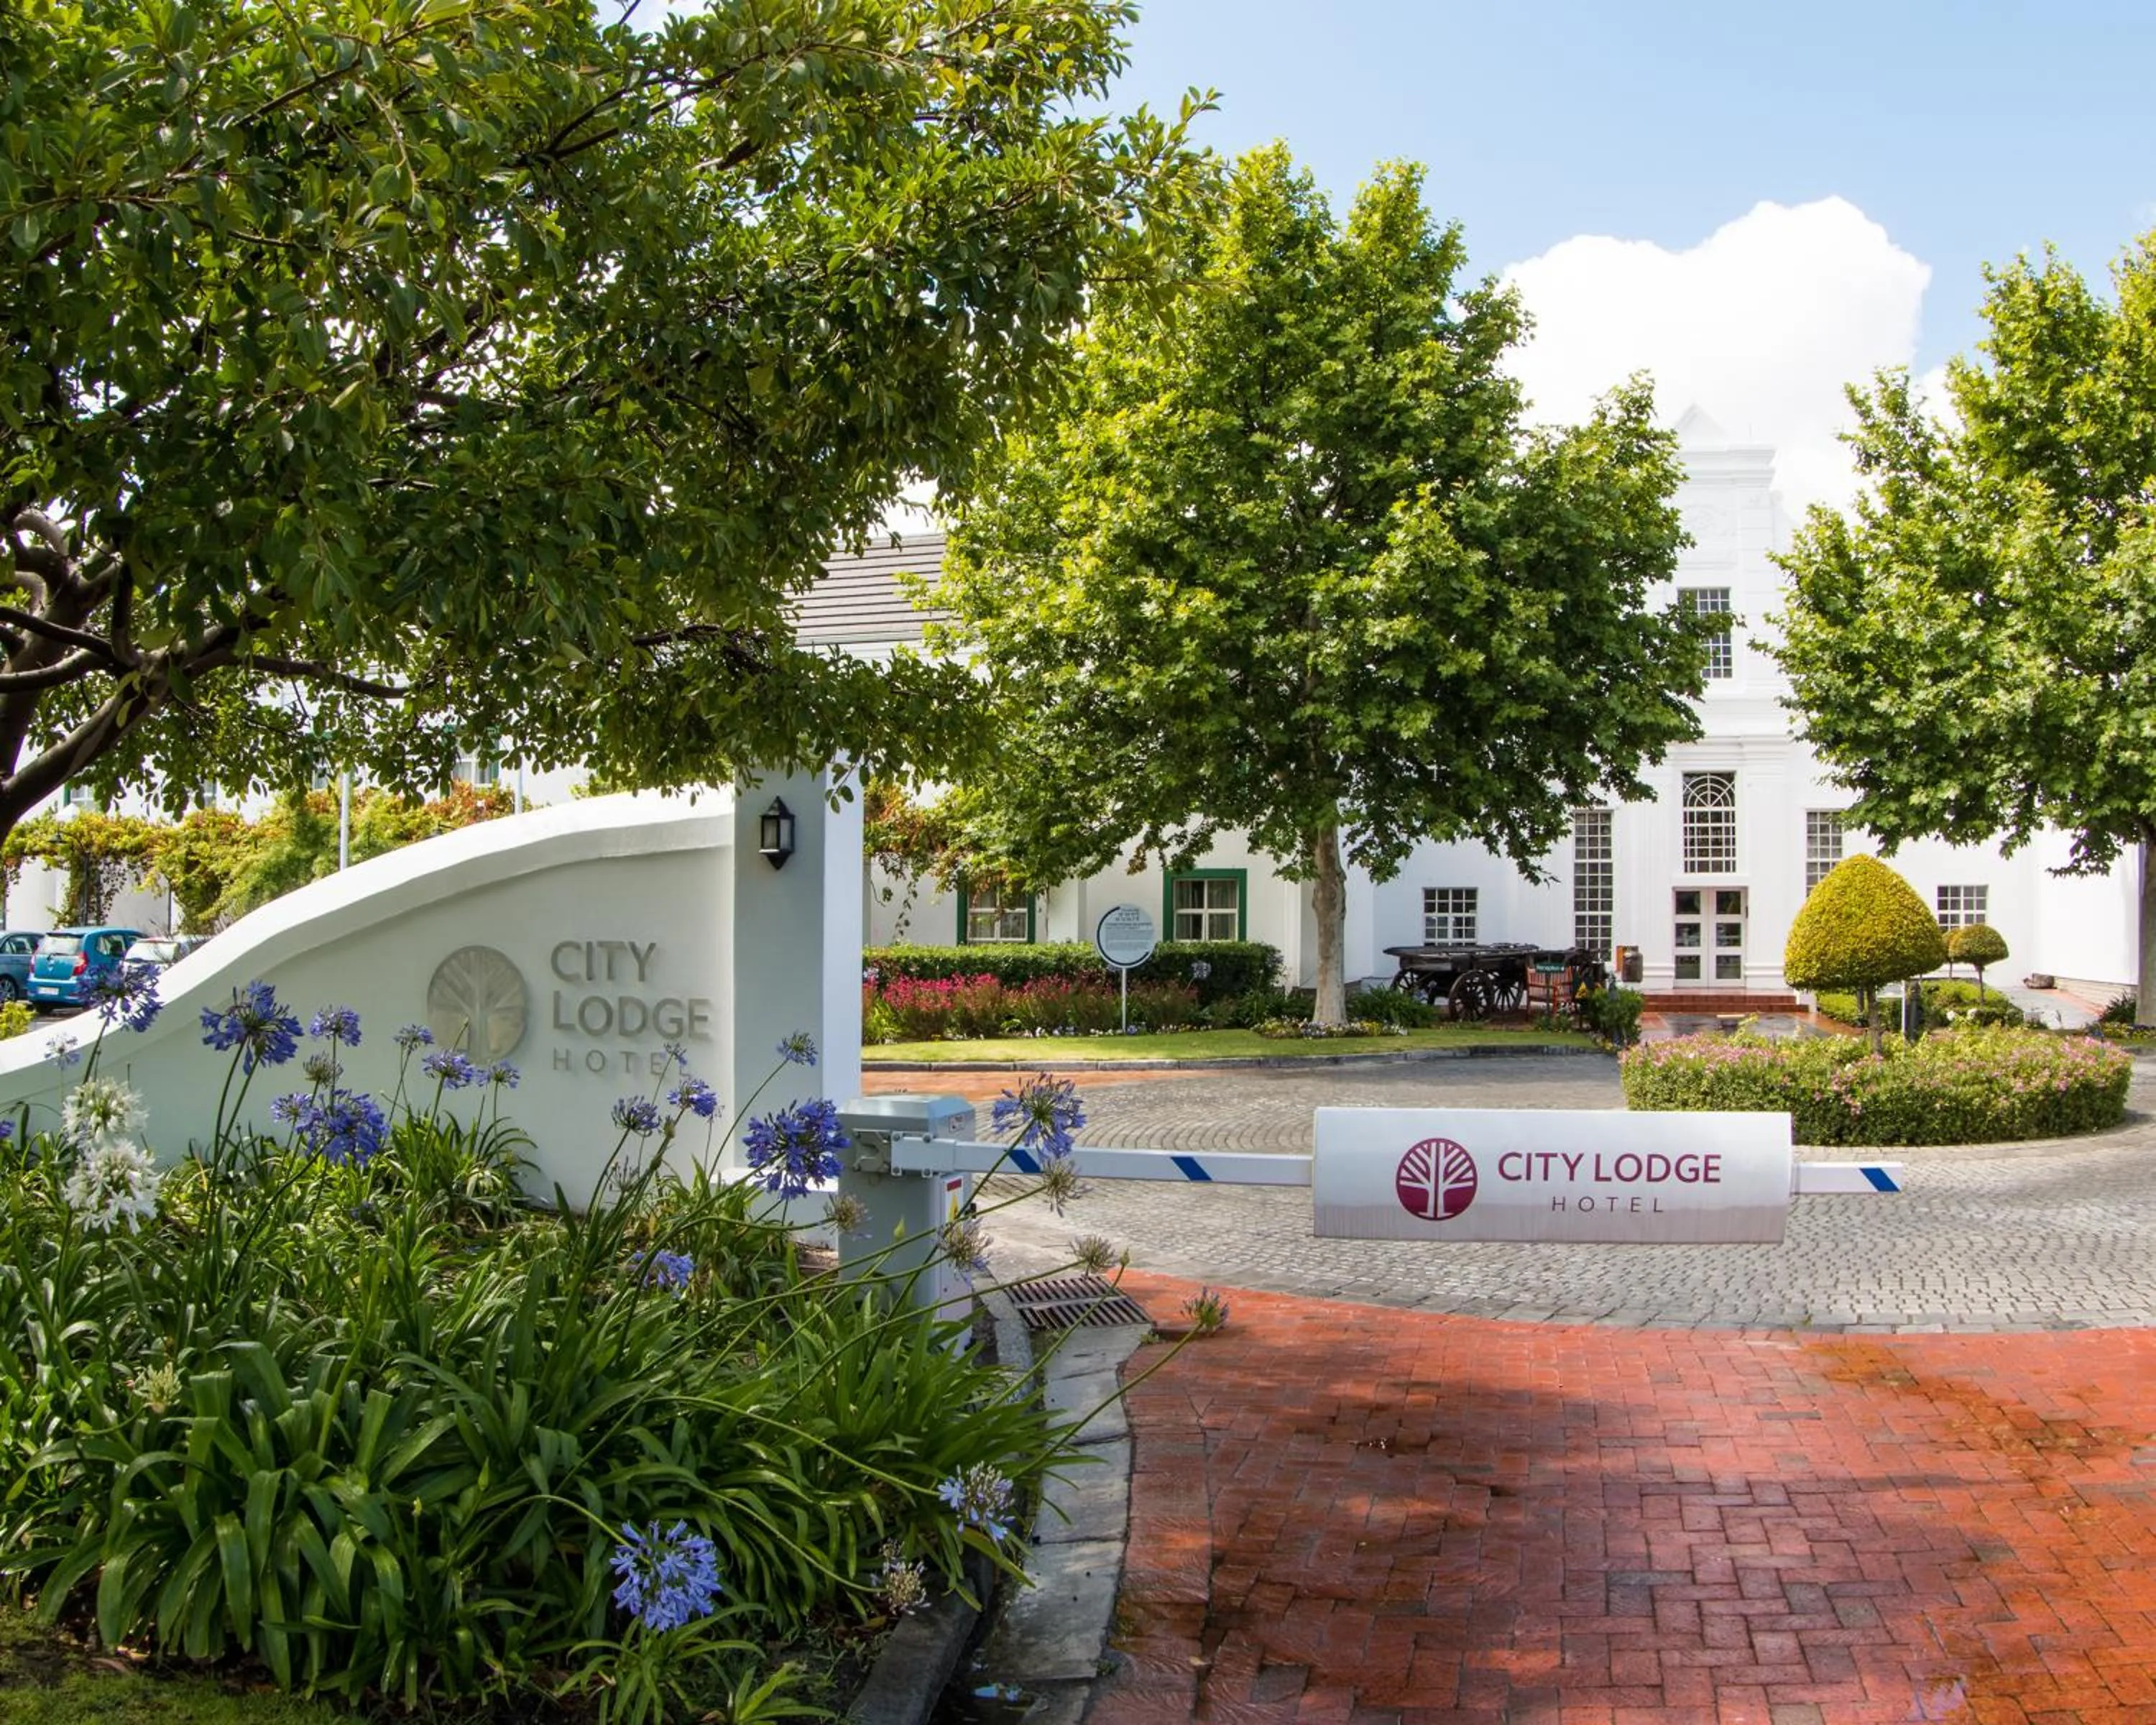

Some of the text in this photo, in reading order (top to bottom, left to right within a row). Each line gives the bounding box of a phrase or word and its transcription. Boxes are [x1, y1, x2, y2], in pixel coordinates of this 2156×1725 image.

[550, 940, 657, 983] CITY
[553, 990, 712, 1040] LODGE
[1498, 1151, 1722, 1183] CITY LODGE
[1552, 1195, 1664, 1213] HOTEL
